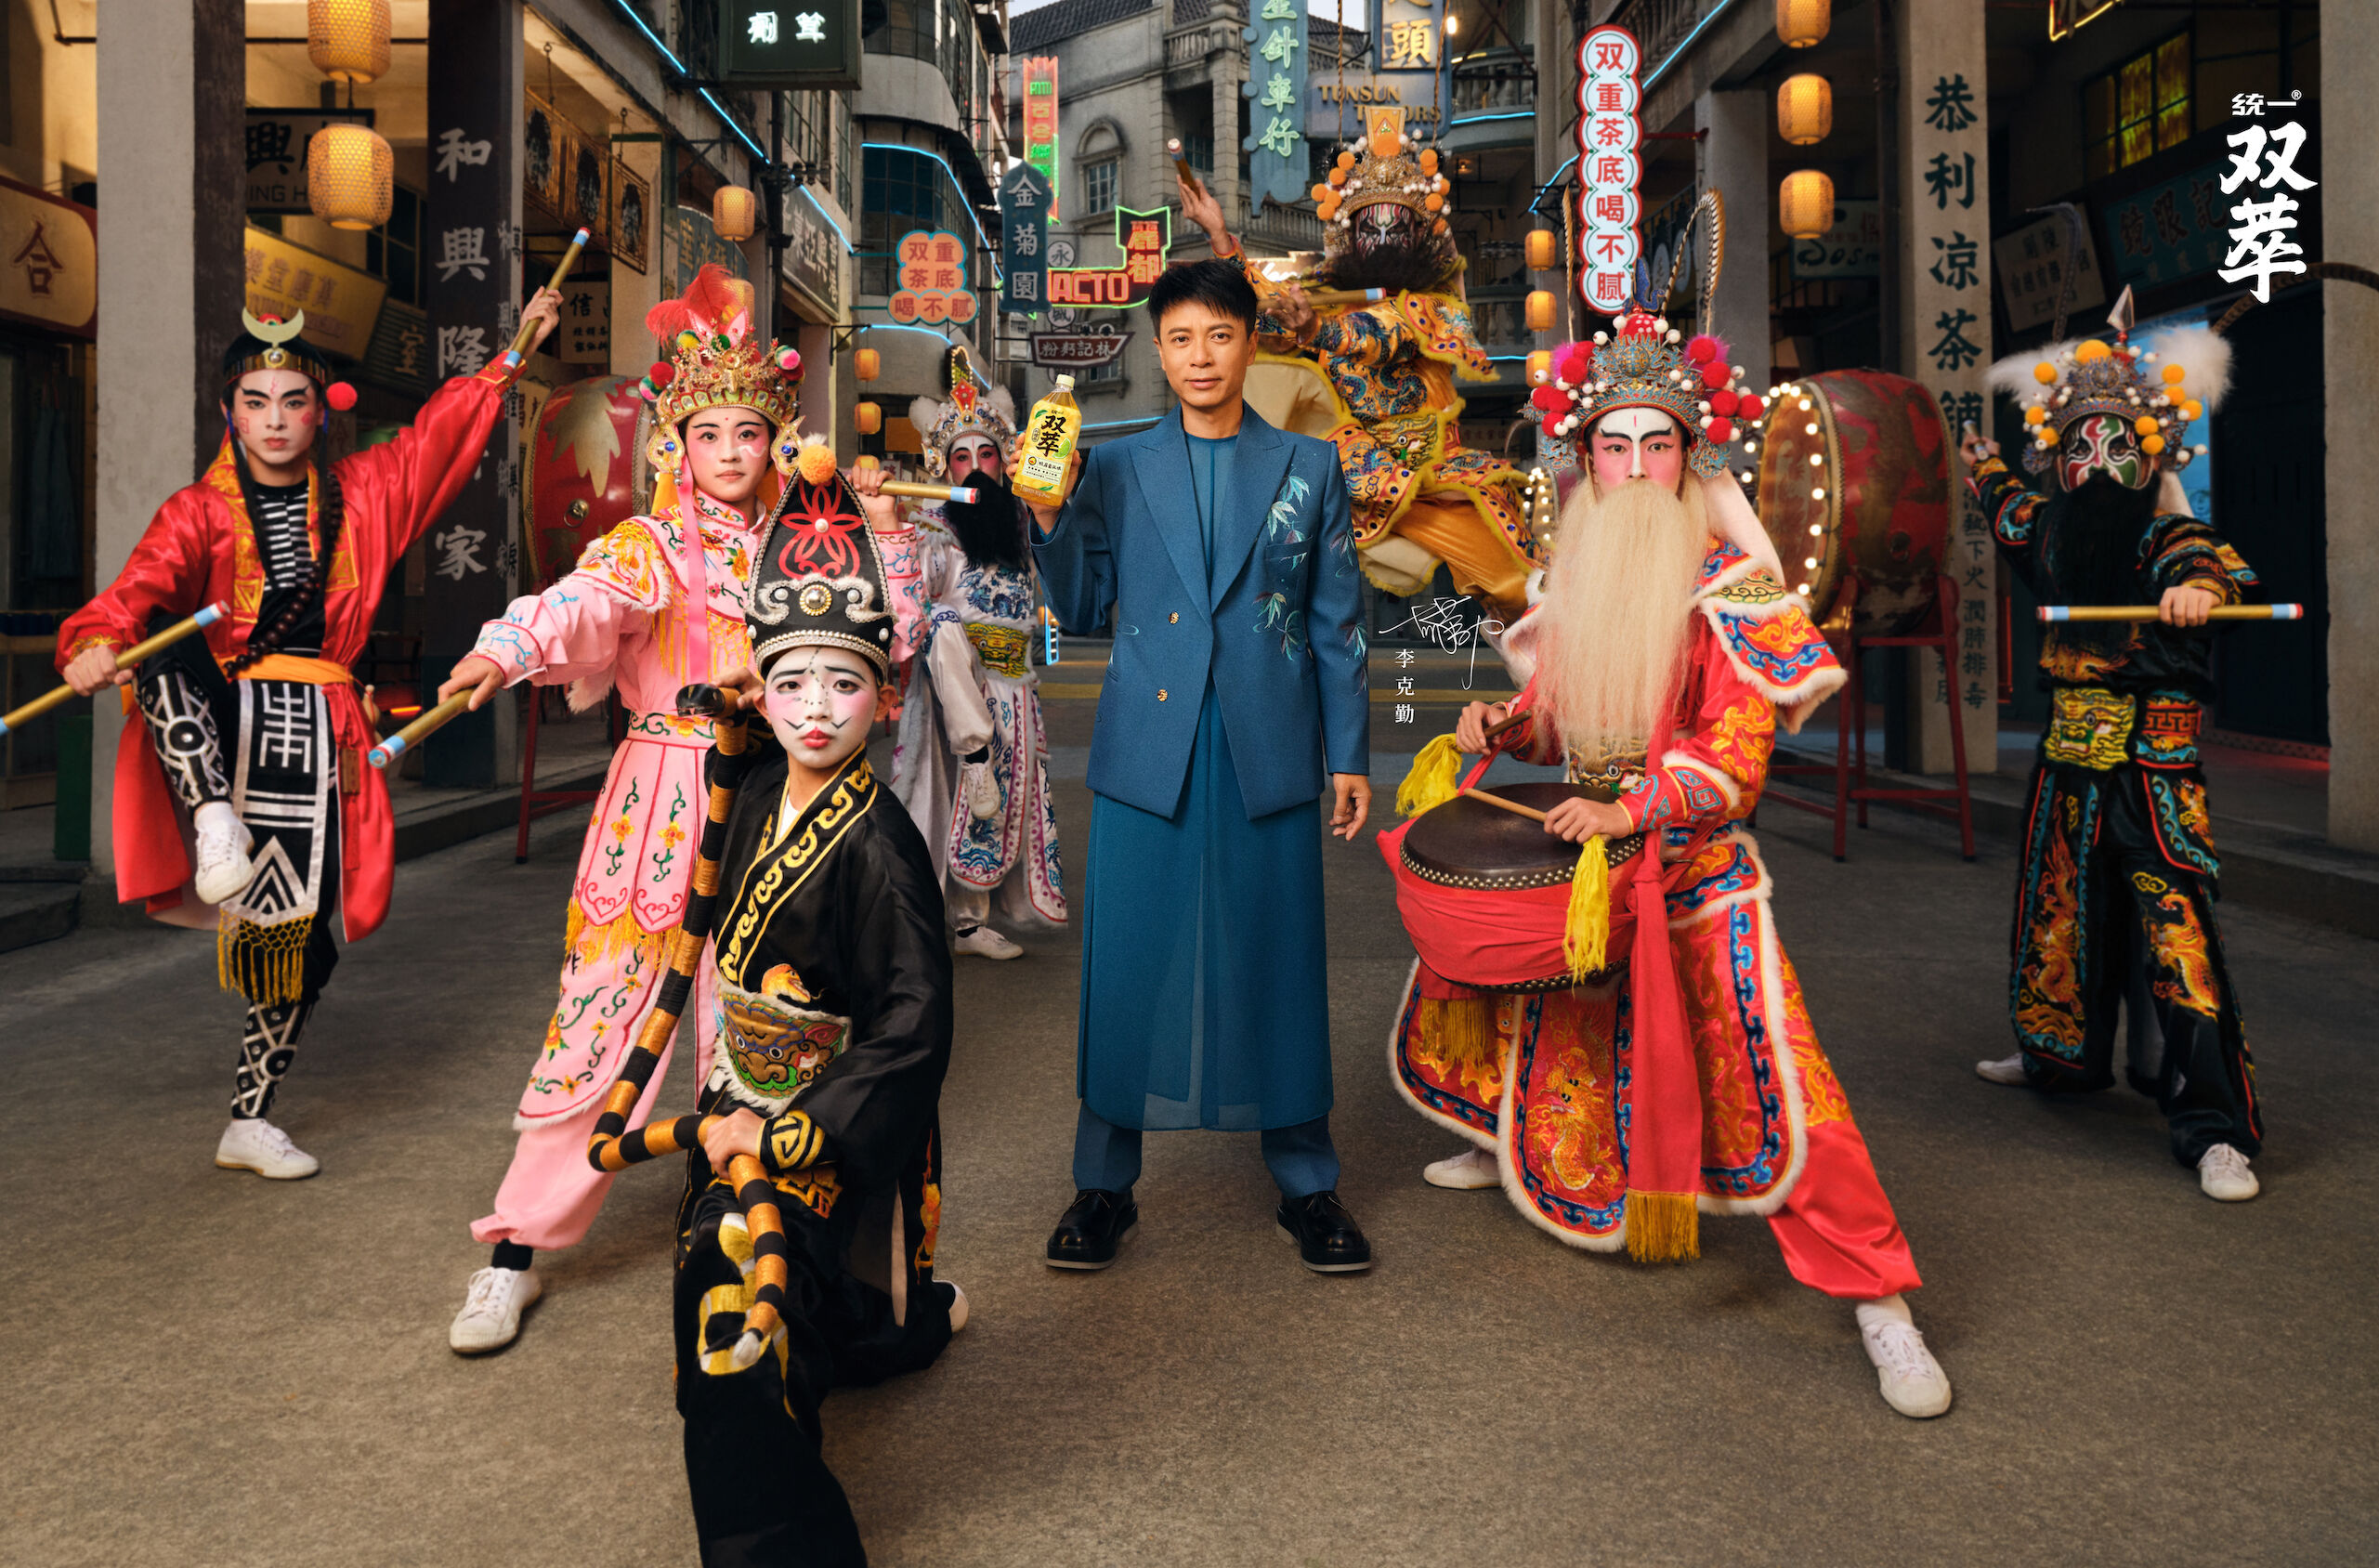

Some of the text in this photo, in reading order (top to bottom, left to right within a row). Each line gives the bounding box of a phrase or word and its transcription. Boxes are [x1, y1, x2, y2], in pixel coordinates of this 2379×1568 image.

[1318, 85, 1401, 103] TUNSUN
[1353, 104, 1442, 122] TORS
[1595, 43, 1626, 301] 双重茶底喝不腻
[14, 220, 63, 294] 合
[908, 242, 955, 262] 双重
[1008, 174, 1042, 302] 金菊園
[1128, 220, 1160, 283] 麗都
[908, 268, 955, 289] 茶底
[1049, 268, 1130, 303] ACTO
[895, 297, 972, 318] 喝不腻
[435, 126, 493, 581] 和興隆家
[1036, 415, 1066, 457] 双萃
